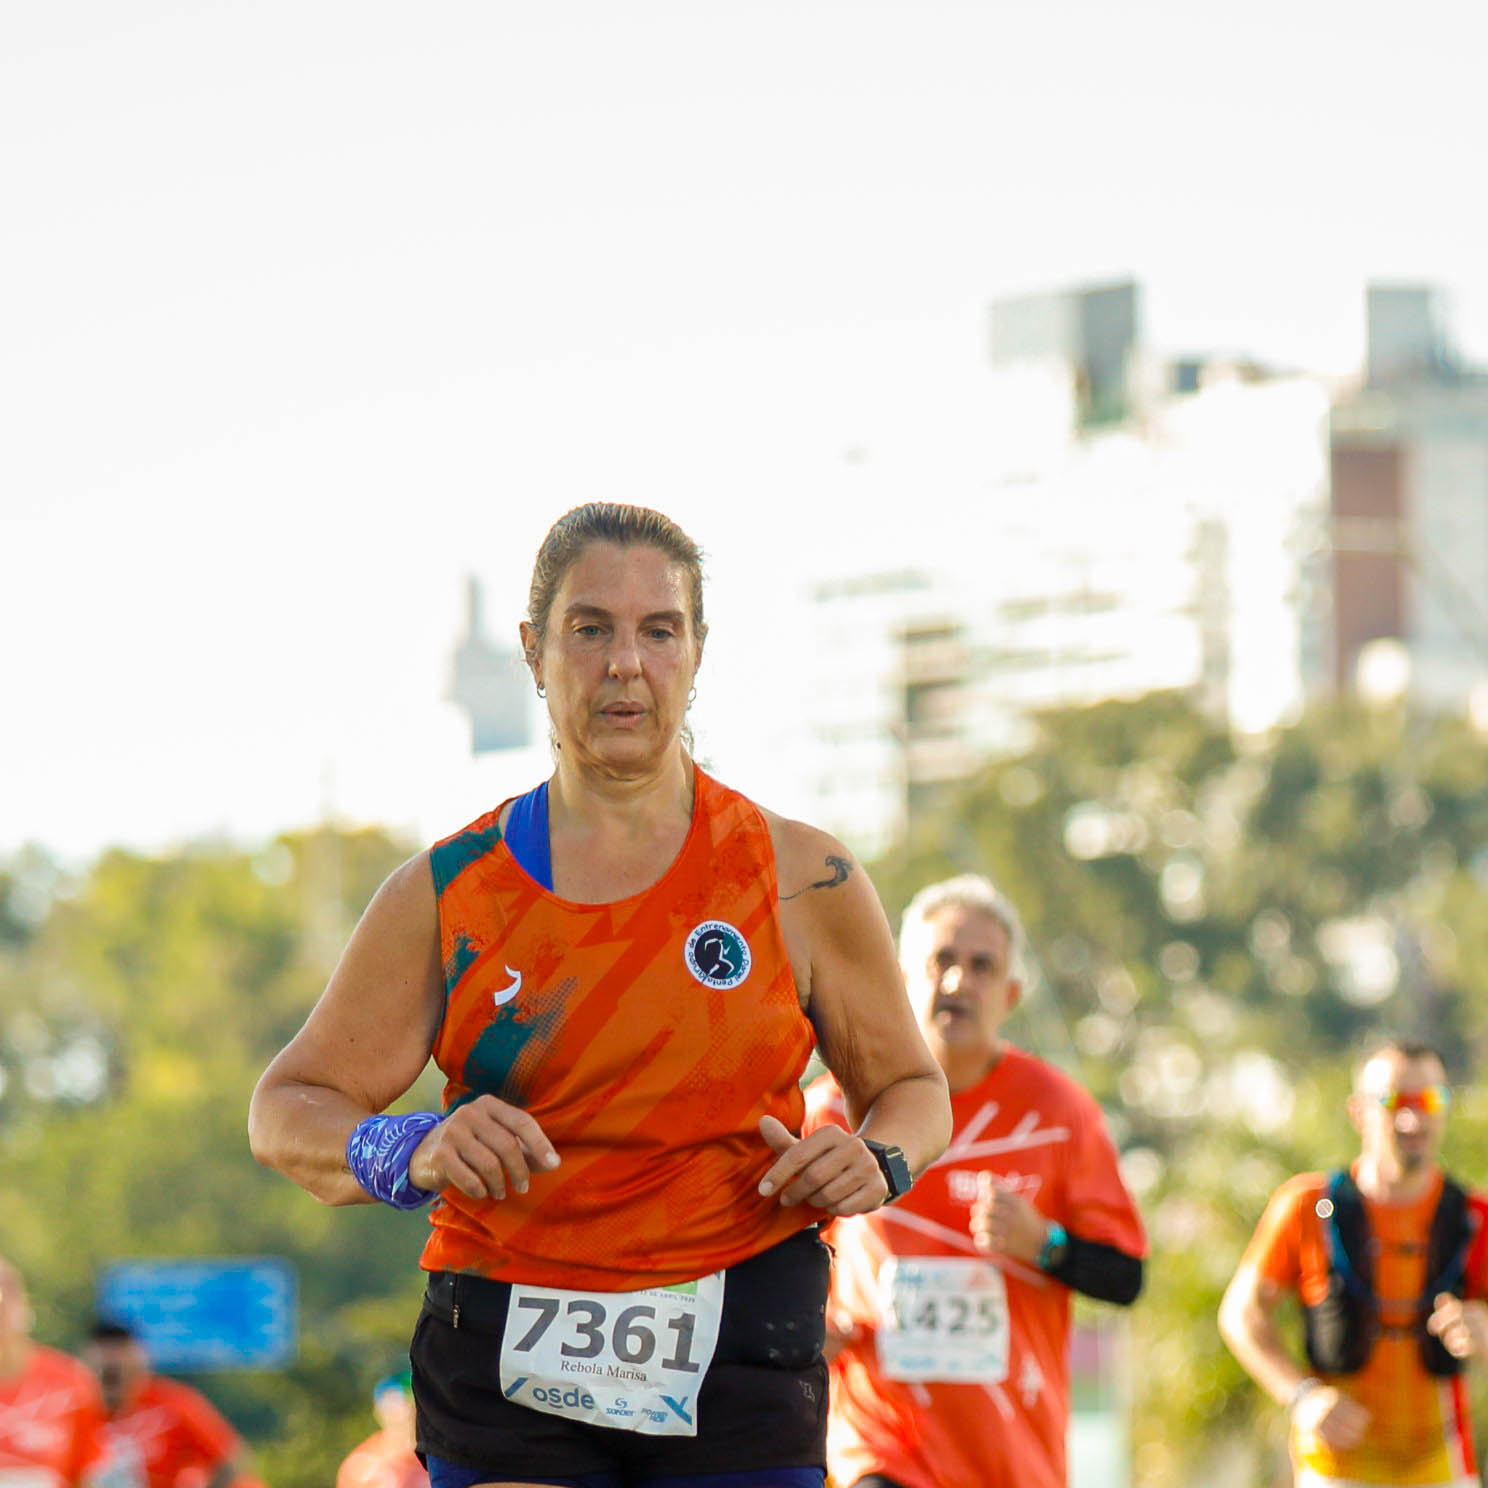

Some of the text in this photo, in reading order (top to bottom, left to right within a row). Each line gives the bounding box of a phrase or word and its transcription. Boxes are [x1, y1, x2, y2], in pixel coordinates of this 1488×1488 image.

[891, 1297, 1001, 1334] 425
[513, 1297, 700, 1373] 7361
[561, 1360, 648, 1381] Rebola Marisa
[533, 1387, 595, 1409] osde
